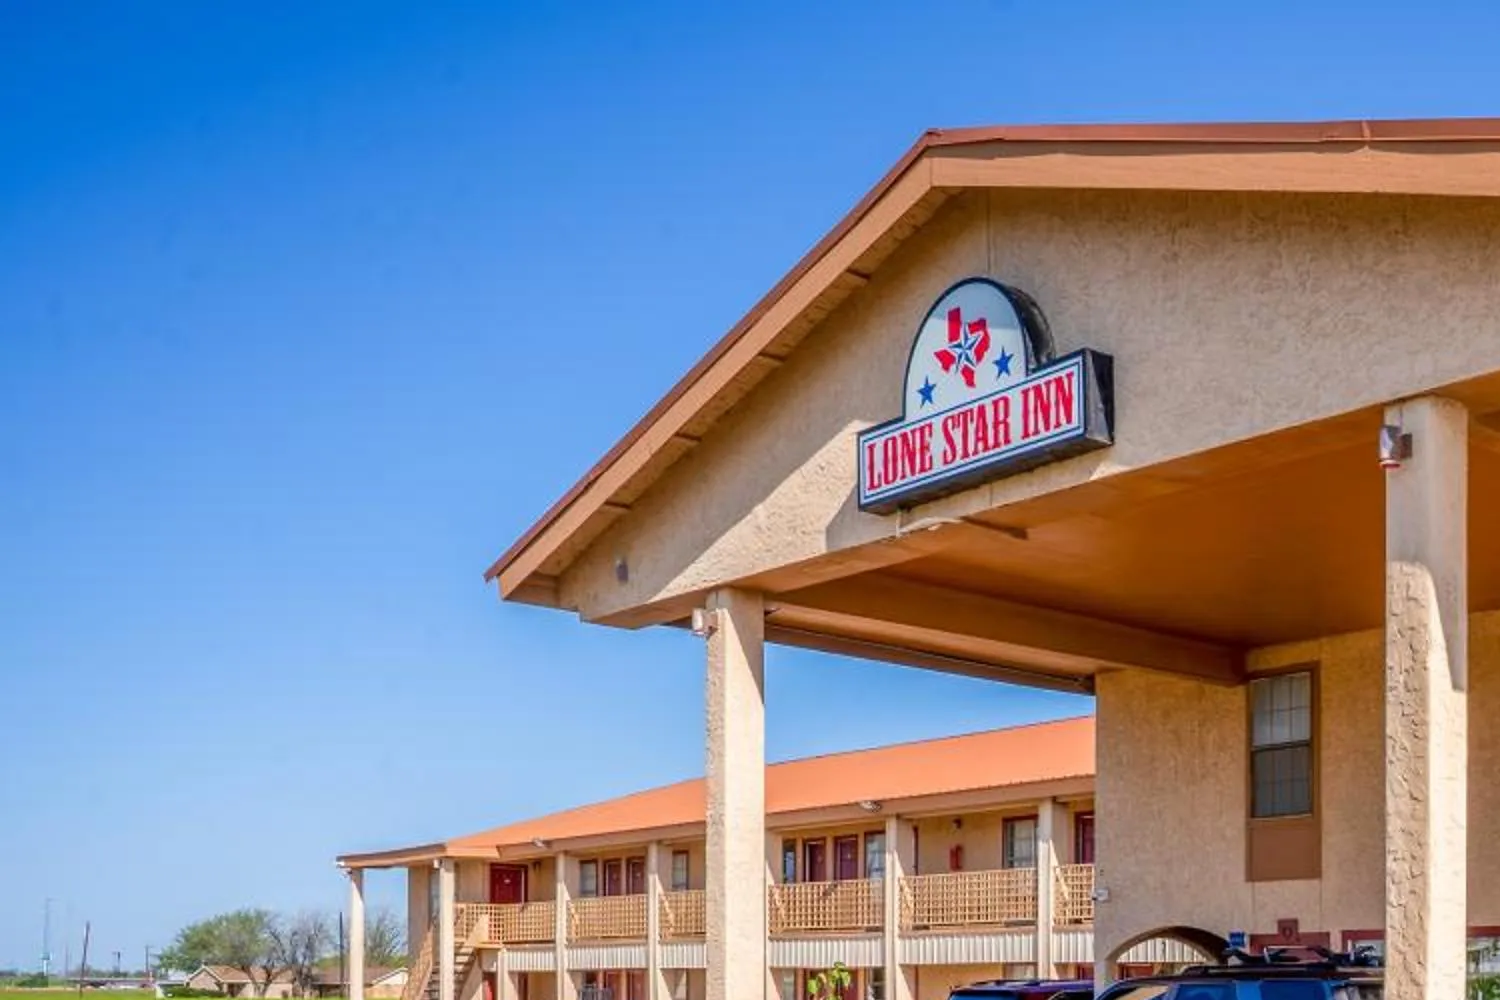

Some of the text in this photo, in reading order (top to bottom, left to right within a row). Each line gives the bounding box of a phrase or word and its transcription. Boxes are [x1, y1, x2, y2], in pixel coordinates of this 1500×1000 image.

[867, 370, 1075, 492] LONE STAR INN
